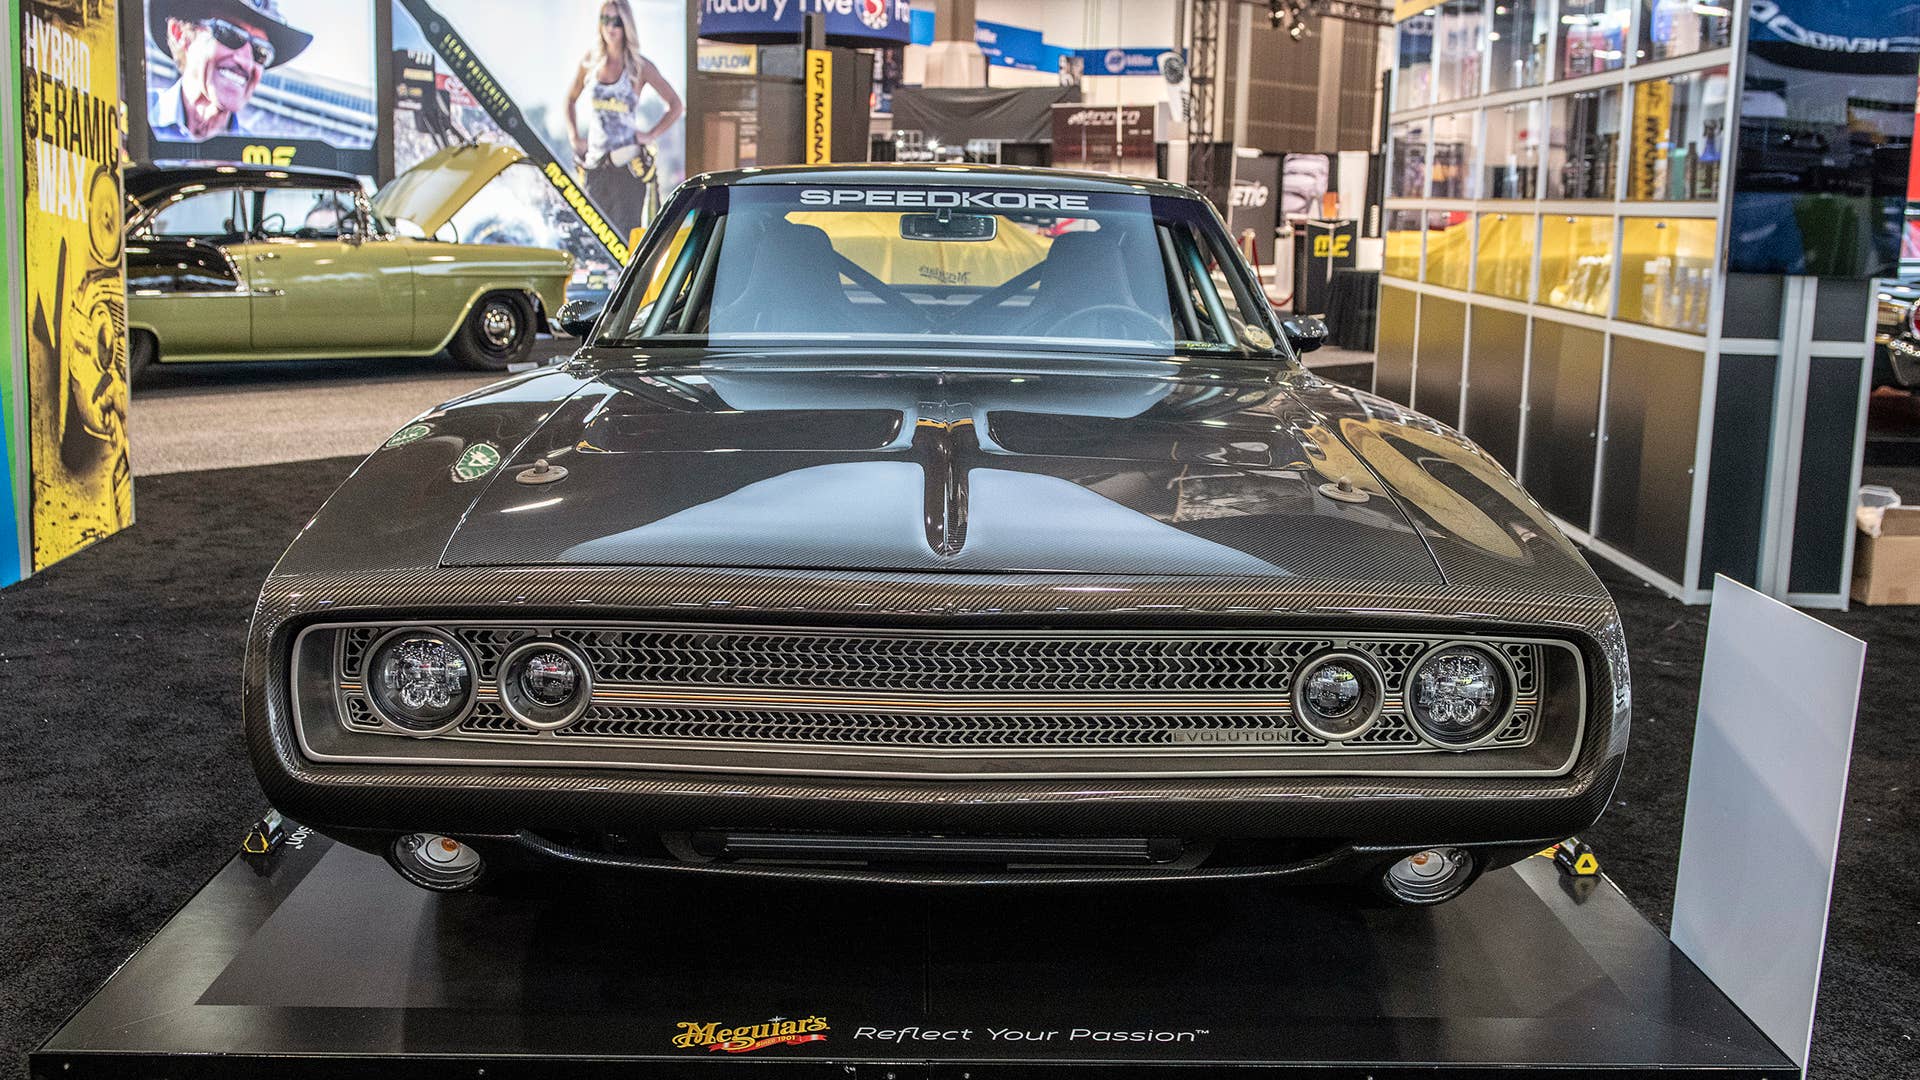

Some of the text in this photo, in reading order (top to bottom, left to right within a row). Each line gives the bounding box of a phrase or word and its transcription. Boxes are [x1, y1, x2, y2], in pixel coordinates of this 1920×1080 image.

[25, 11, 90, 95] HYBRID
[25, 66, 119, 170] CERAMIC
[814, 92, 824, 163] MAGNA
[35, 138, 88, 224] WAX
[800, 189, 1089, 211] SPEEDKORE
[1173, 731, 1290, 742] EVOLUTION
[672, 1015, 830, 1051] Meguiar's
[777, 1034, 796, 1043] 1901
[854, 1026, 973, 1043] Reflect
[987, 1027, 1059, 1042] Your
